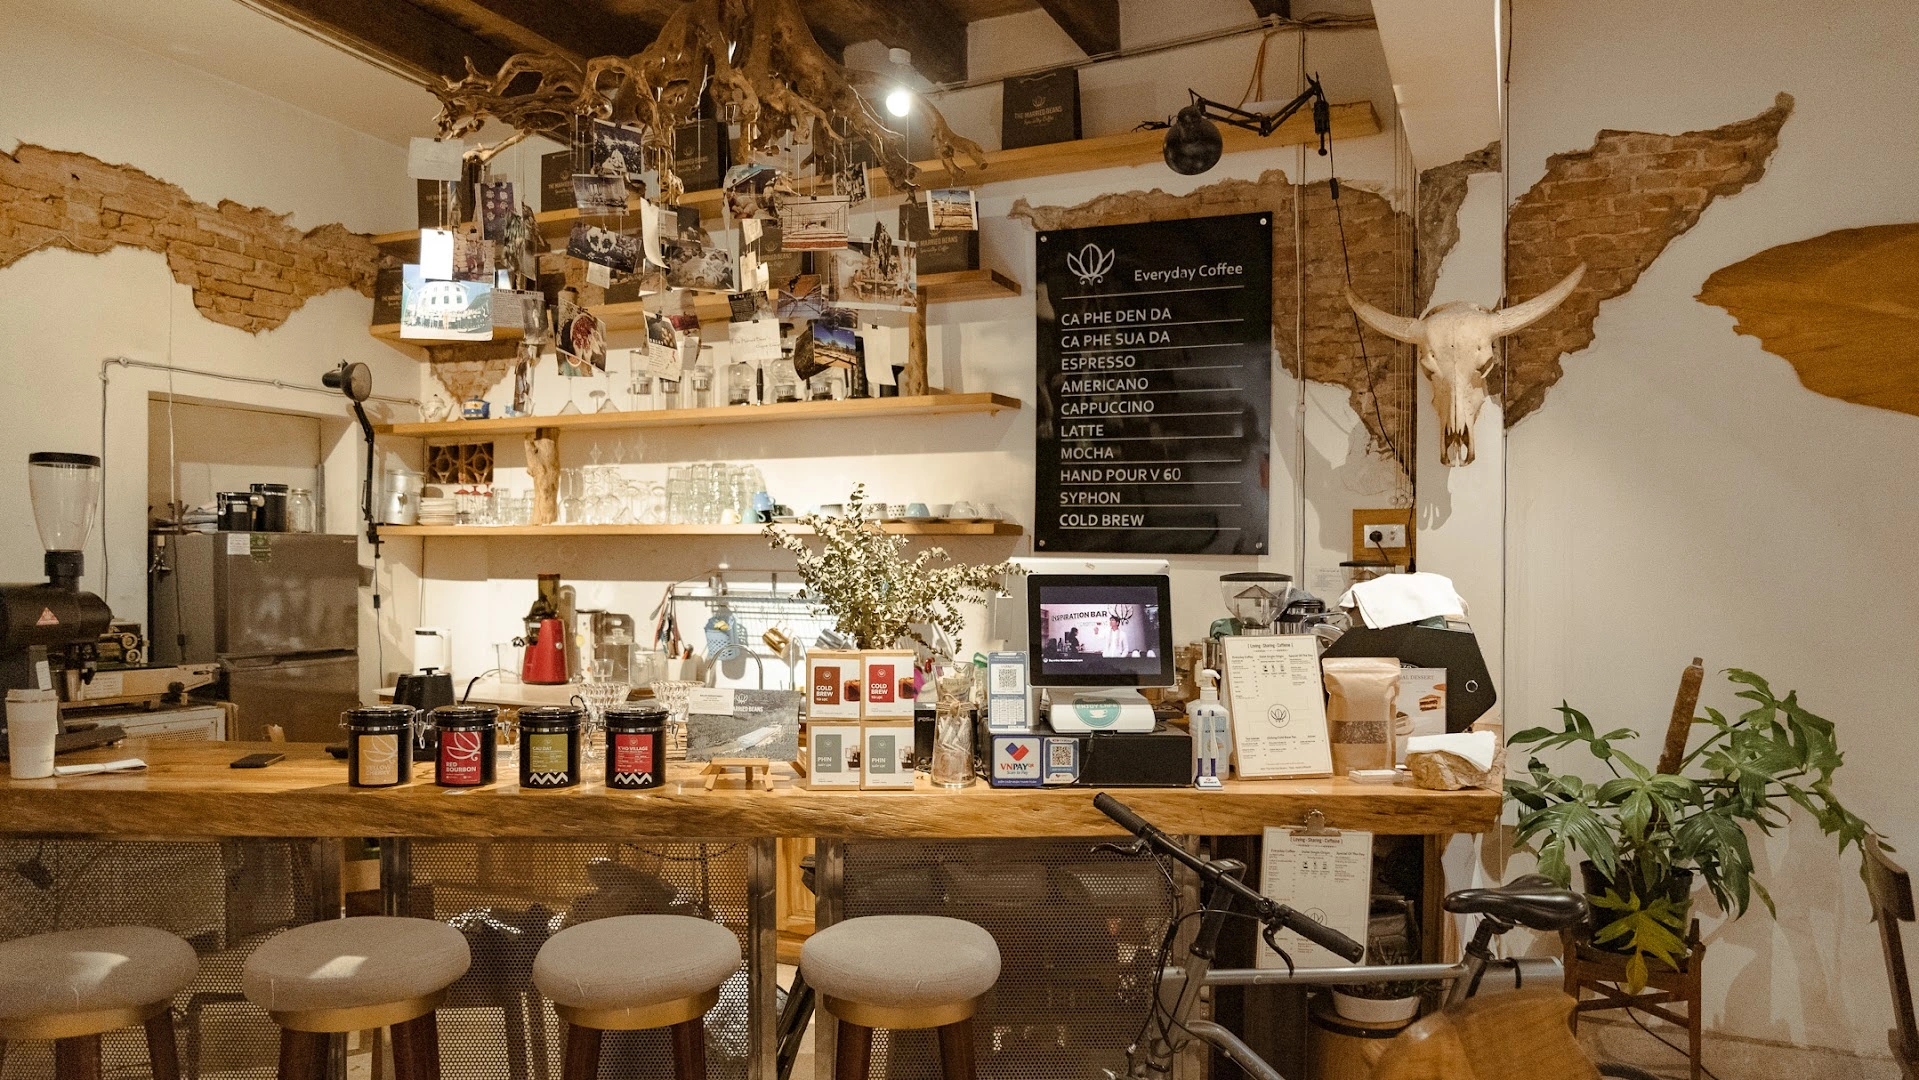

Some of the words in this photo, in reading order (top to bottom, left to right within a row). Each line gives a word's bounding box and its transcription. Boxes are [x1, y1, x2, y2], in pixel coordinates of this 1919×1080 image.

[1024, 108, 1046, 118] MARRIED
[1045, 105, 1063, 114] BEANS
[941, 236, 958, 244] BEANS
[1134, 266, 1196, 283] Everyday
[1199, 262, 1243, 278] Coffee
[1061, 313, 1080, 326] CA
[1083, 311, 1112, 325] PHE
[1115, 309, 1147, 323] DEN
[1150, 307, 1172, 321] DA
[1061, 335, 1080, 349] CA
[1083, 333, 1112, 347] PHE
[1115, 332, 1146, 346] SUA
[1149, 330, 1171, 344] DA
[1061, 355, 1136, 371] ESPRESSO
[1061, 377, 1149, 393] AMERICANO
[1061, 400, 1155, 416] CAPPUCCINO
[1060, 424, 1104, 437] LATTE
[1060, 447, 1114, 460] MOCHA
[1060, 469, 1103, 482] HAND
[1106, 468, 1147, 482] POUR
[1149, 468, 1160, 481] V
[1163, 468, 1182, 481] 60
[1060, 491, 1121, 505] SYPHON
[1059, 514, 1098, 527] COLD
[1101, 514, 1144, 527] BREW
[1051, 611, 1090, 621] INSPIRATION
[1090, 610, 1108, 618] BAR
